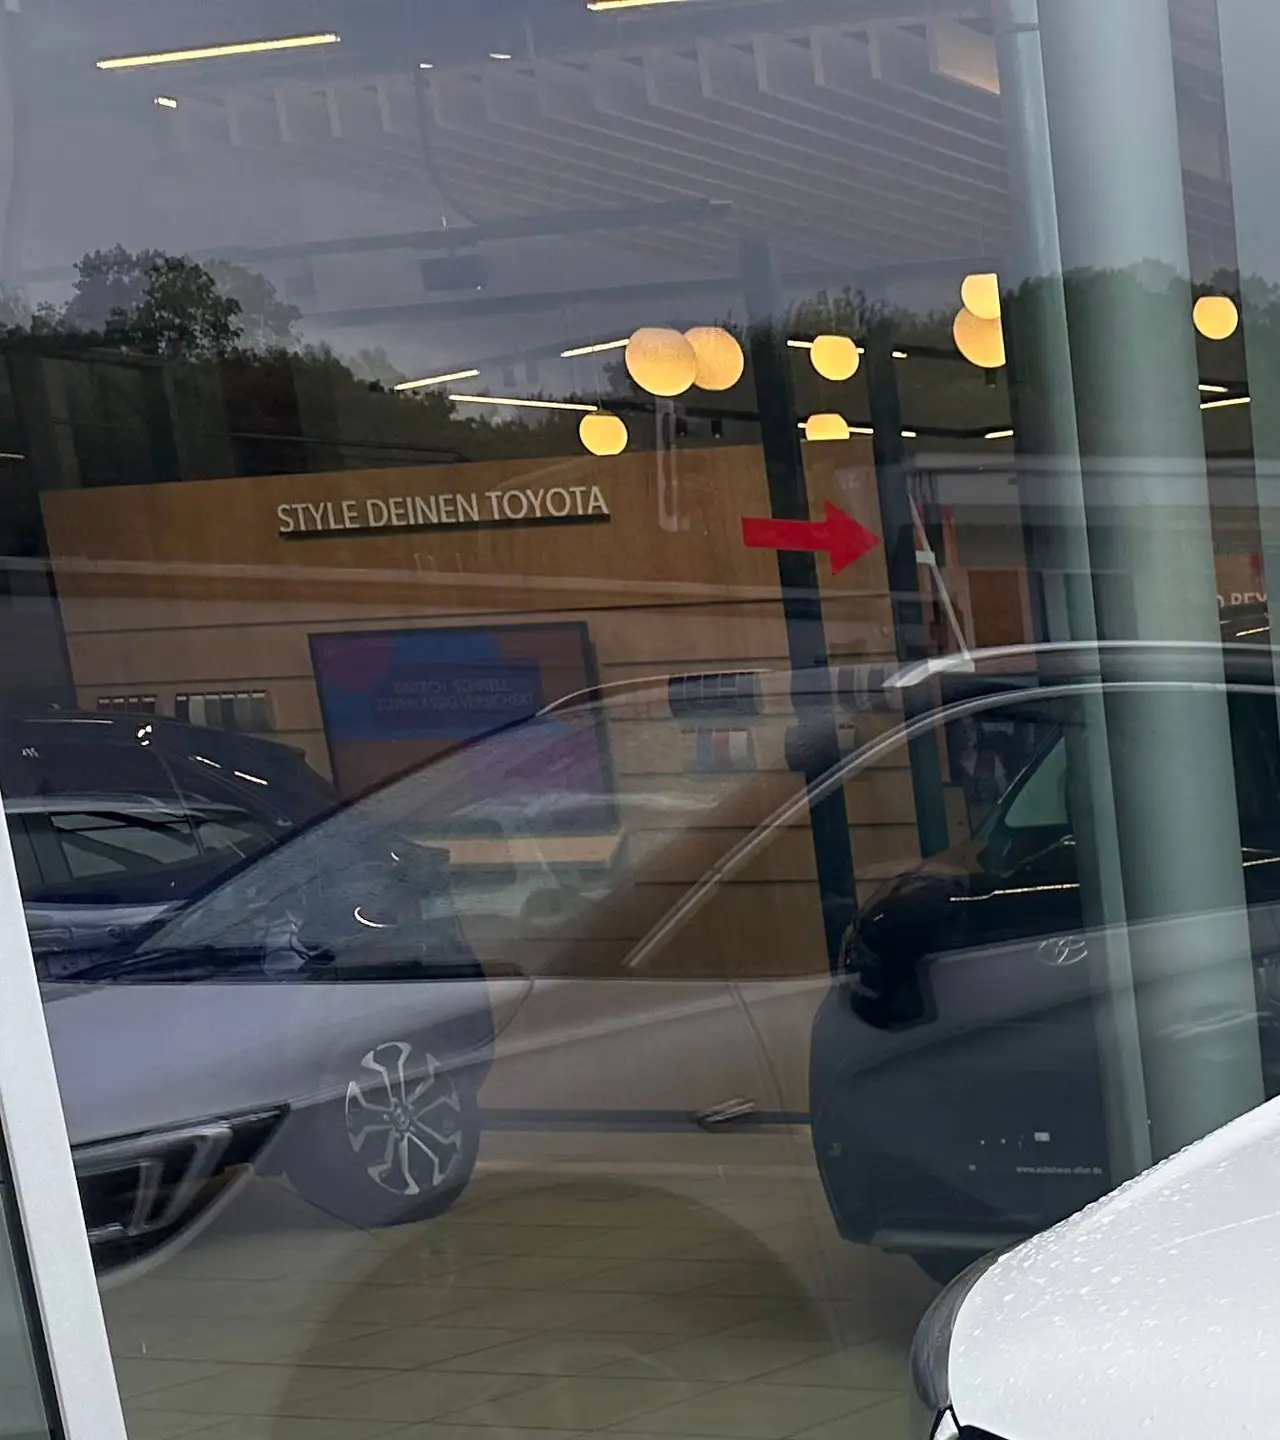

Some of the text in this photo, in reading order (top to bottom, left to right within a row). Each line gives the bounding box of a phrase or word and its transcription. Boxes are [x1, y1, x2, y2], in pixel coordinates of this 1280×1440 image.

[276, 484, 611, 534] STYLE DEINEN TOYOTA
